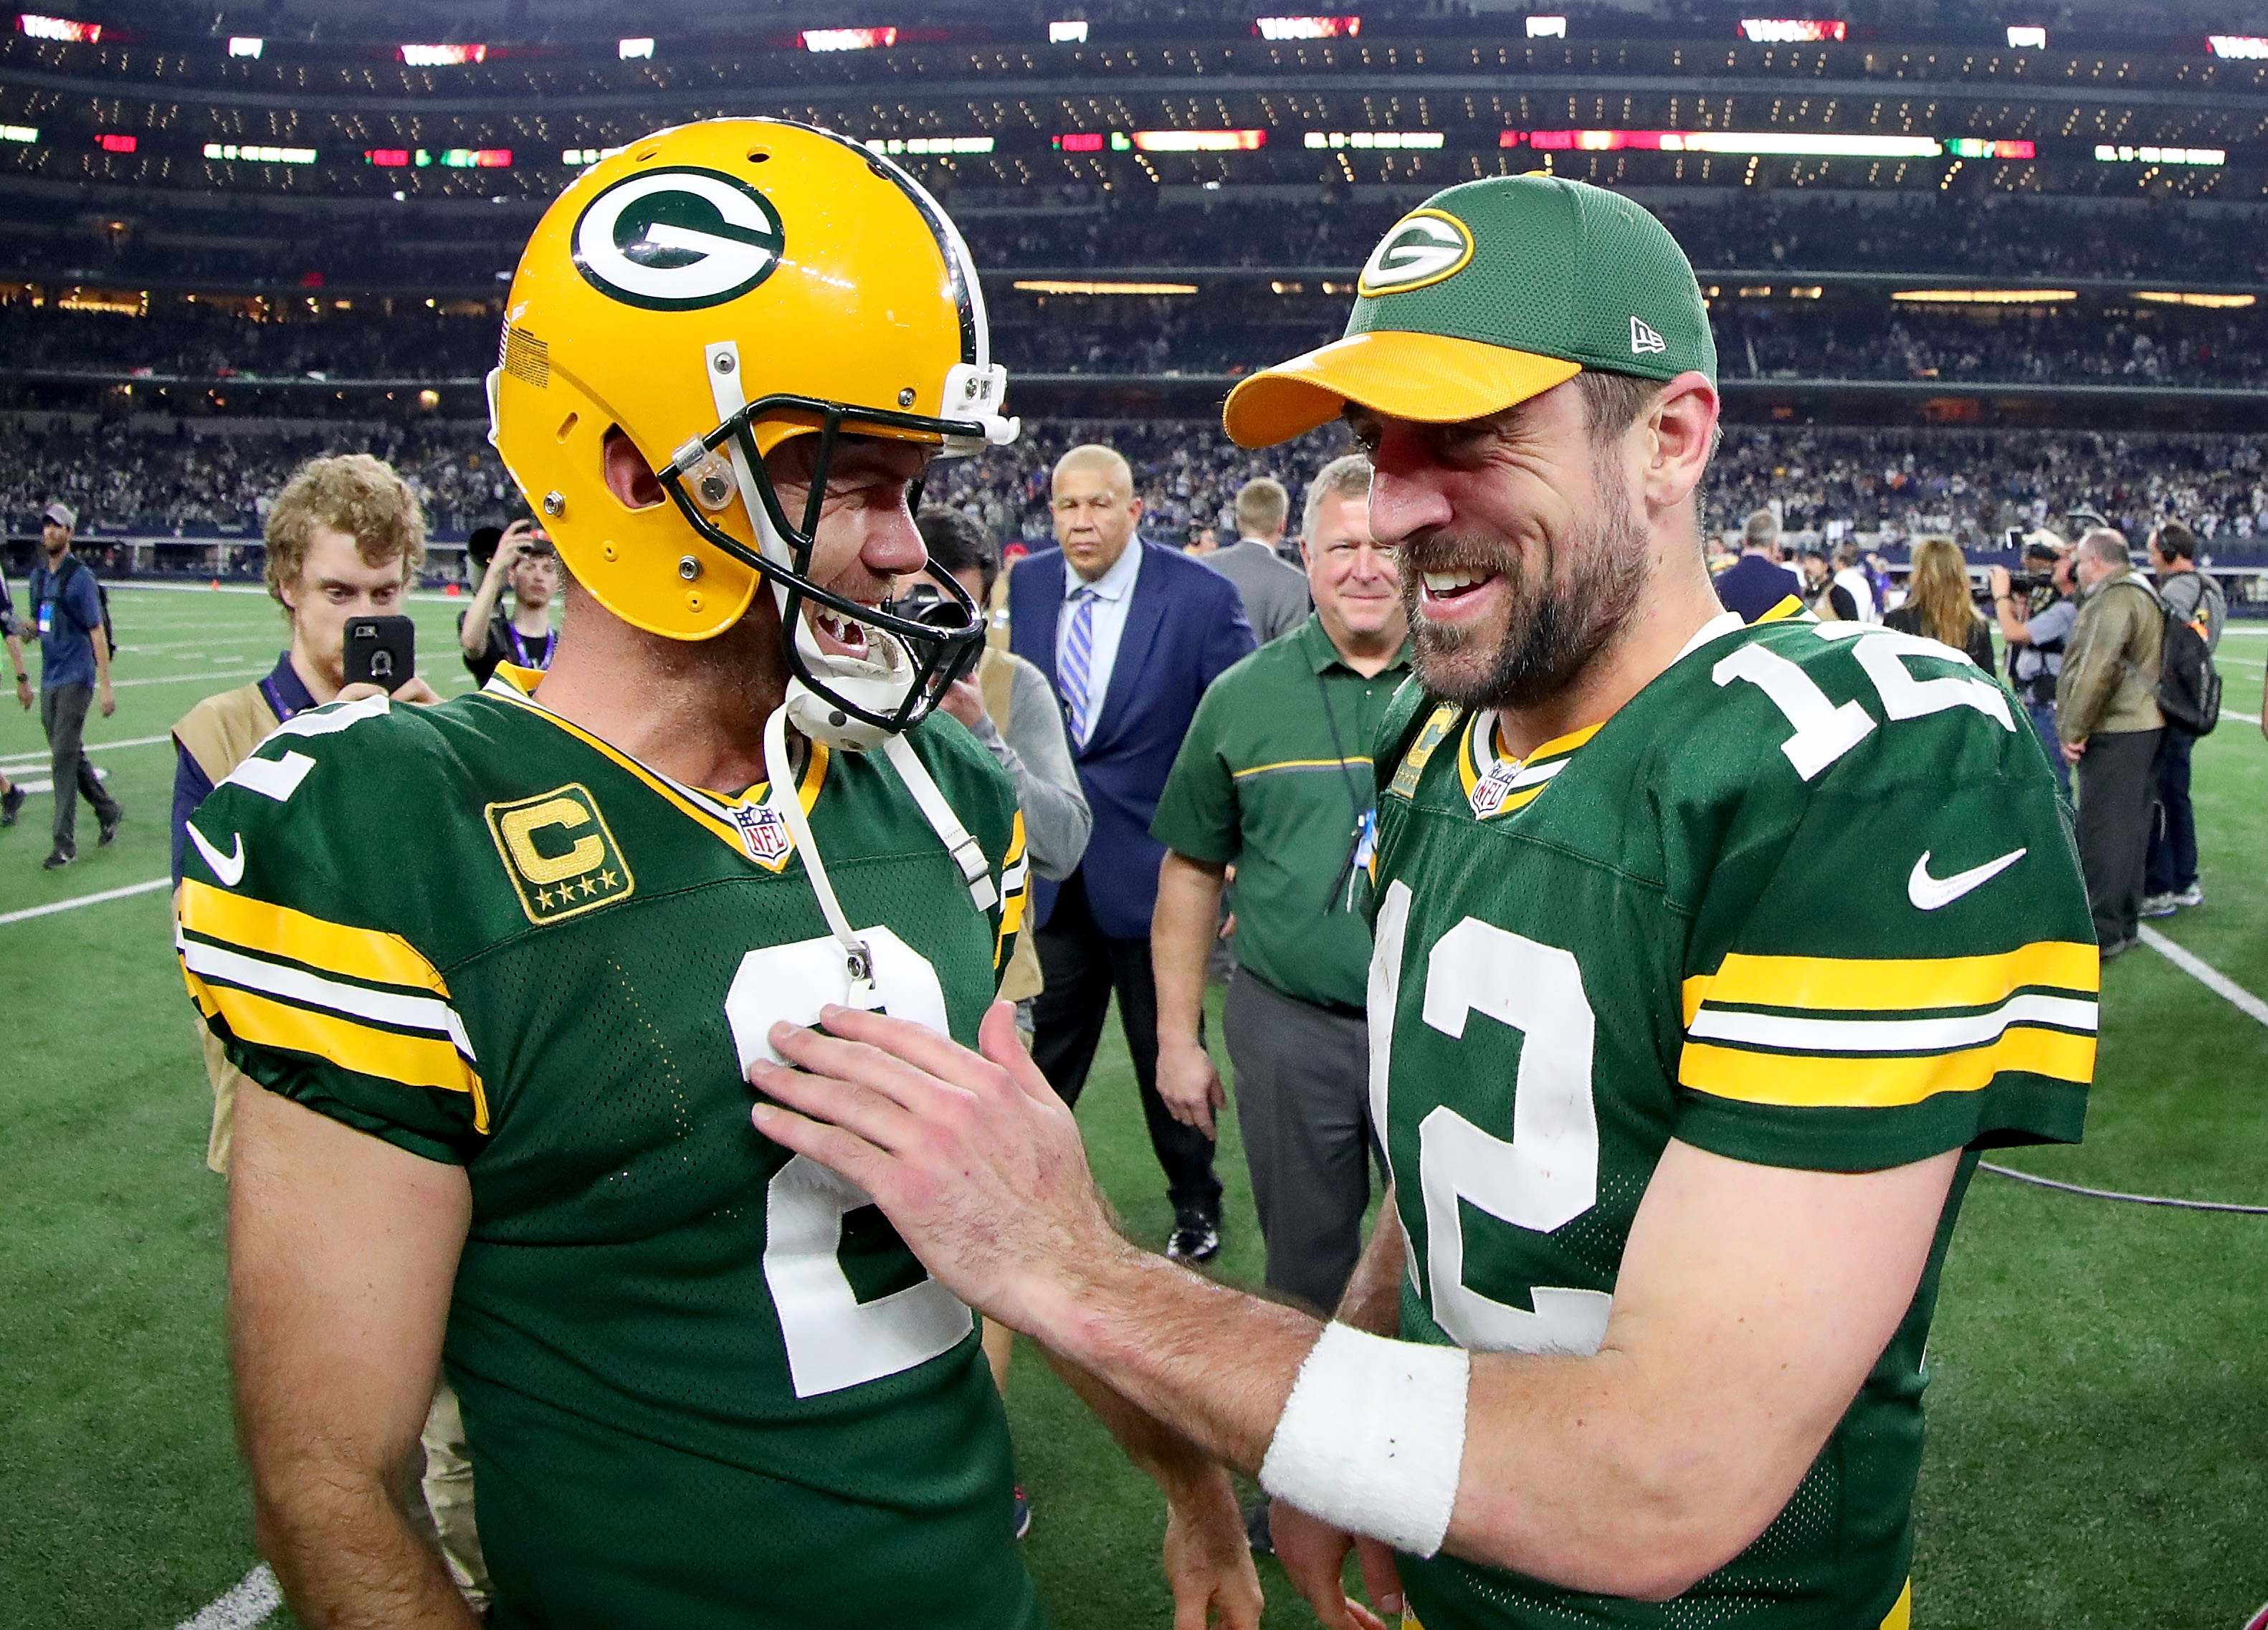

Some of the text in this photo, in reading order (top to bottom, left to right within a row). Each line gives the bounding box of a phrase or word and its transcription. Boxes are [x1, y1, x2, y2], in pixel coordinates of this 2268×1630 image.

[578, 173, 773, 300] G
[1363, 217, 1463, 285] G
[1712, 620, 2016, 782] 12
[1475, 779, 1502, 806] NFL
[501, 798, 605, 884] C
[747, 826, 785, 852] NFL
